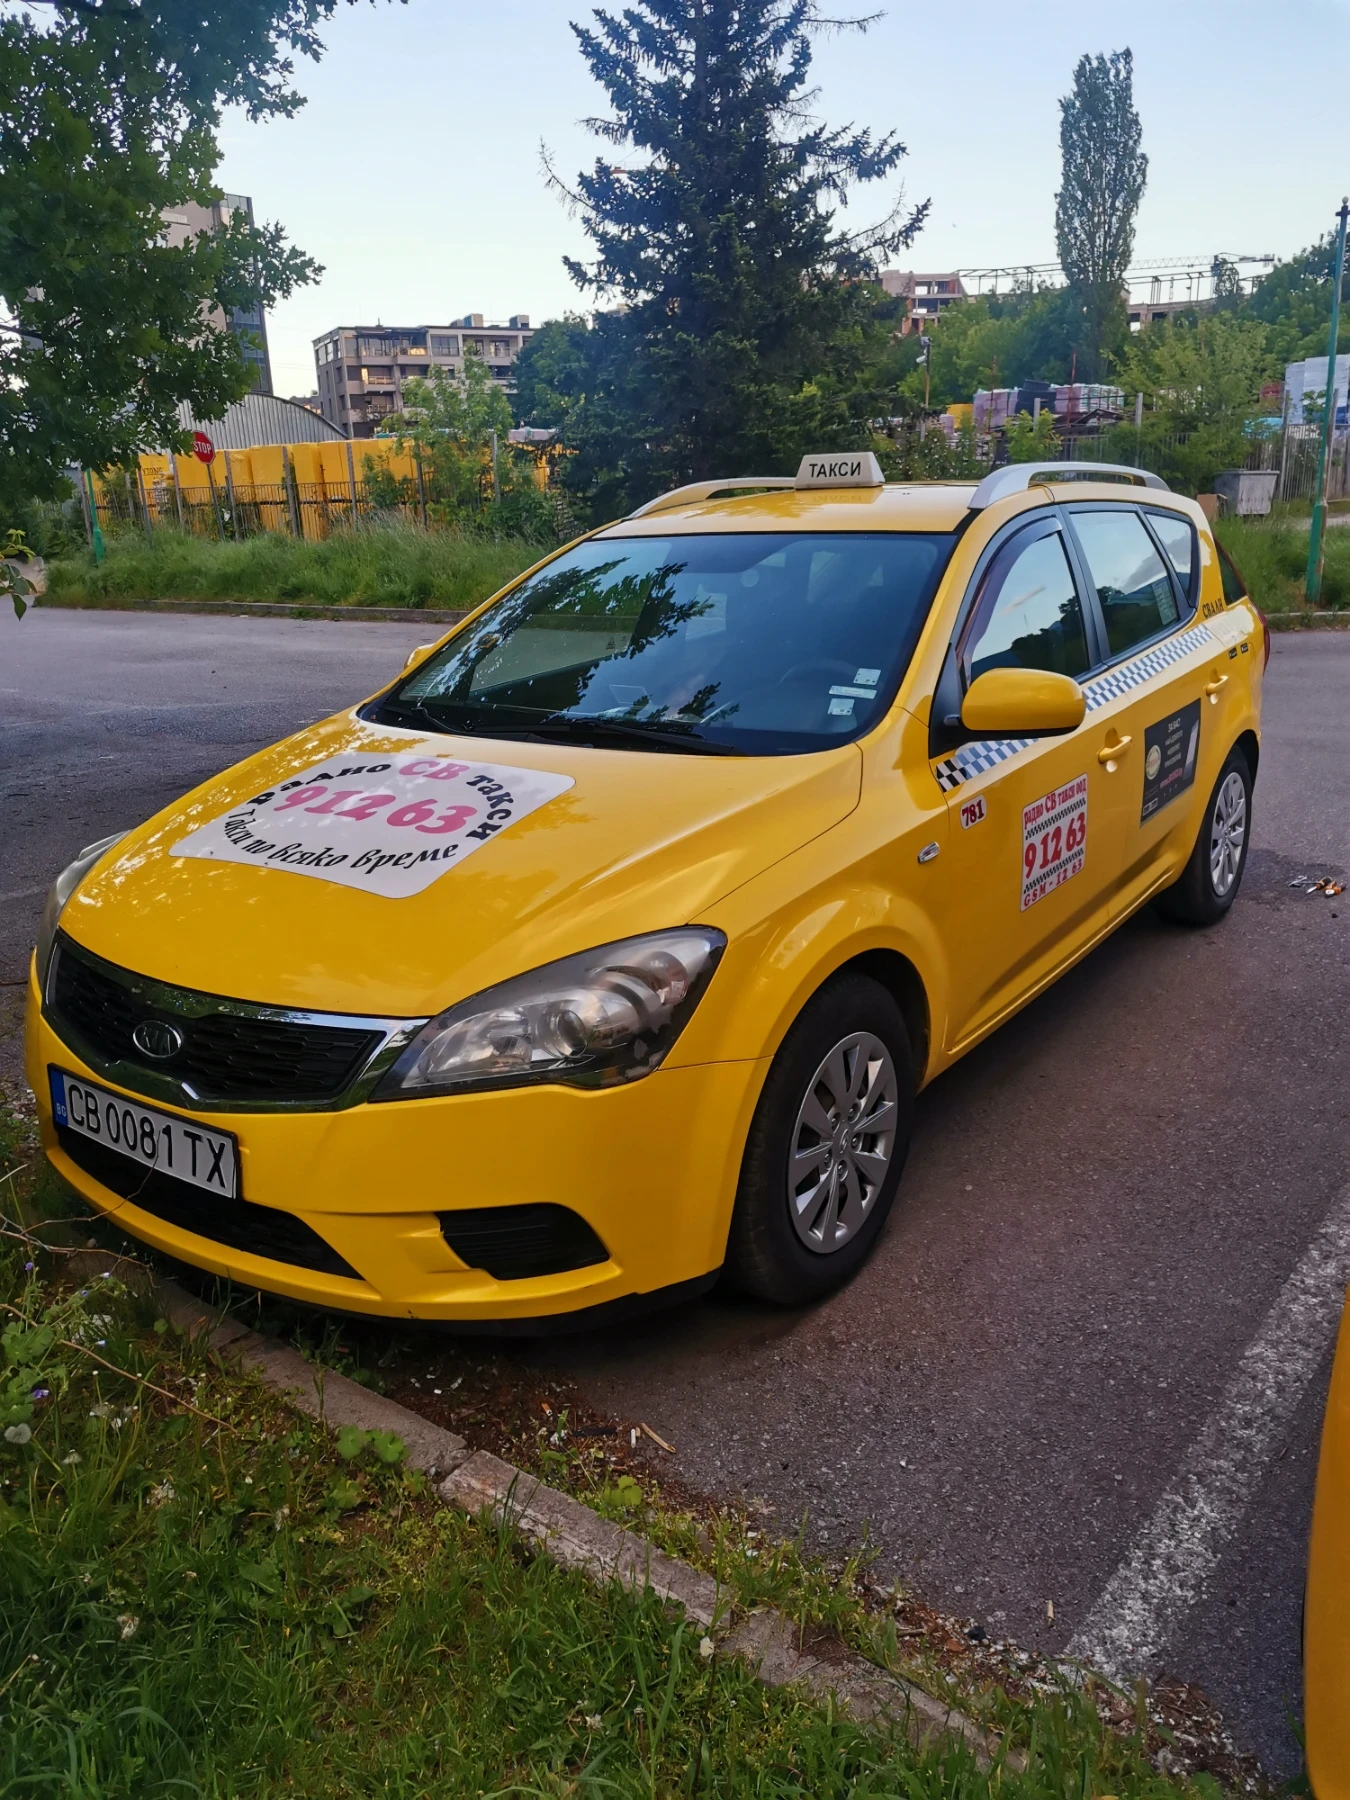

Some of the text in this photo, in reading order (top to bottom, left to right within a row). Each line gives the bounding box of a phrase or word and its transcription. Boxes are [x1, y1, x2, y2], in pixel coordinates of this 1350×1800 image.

[193, 441, 212, 454] STOP
[809, 462, 861, 478] ТАКСИ
[399, 760, 470, 781] СВ
[466, 774, 514, 841] такси
[961, 799, 985, 827] 781
[1023, 804, 1044, 830] радио
[1044, 791, 1057, 813] СВ
[1058, 784, 1075, 807] такси
[224, 808, 460, 876] Такси по всяко време
[1066, 811, 1086, 853] 63
[55, 1102, 68, 1118] BG
[68, 1084, 226, 1189] CB 0081 TX
